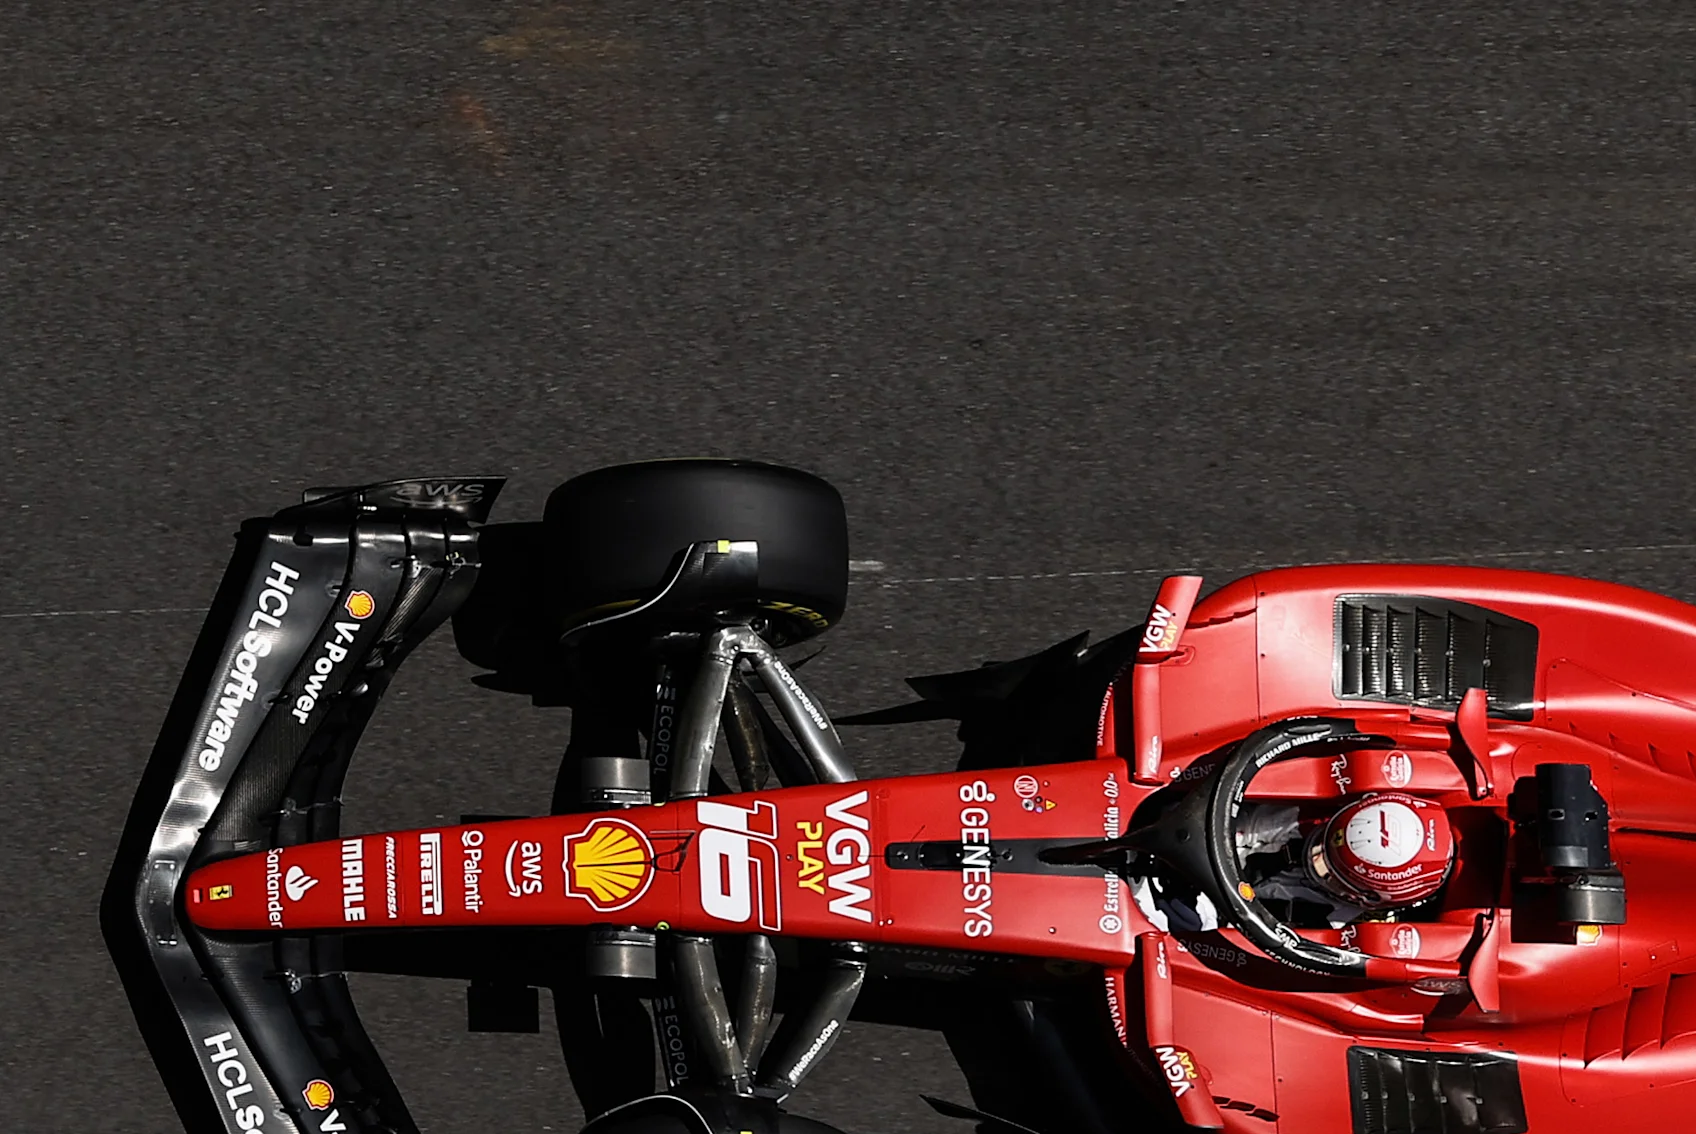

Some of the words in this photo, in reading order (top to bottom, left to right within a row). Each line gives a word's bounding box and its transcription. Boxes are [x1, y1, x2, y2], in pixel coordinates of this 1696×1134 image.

[395, 483, 485, 497] aws
[1139, 604, 1173, 652] VGW
[199, 561, 300, 772] HCLSoftware
[292, 621, 361, 725] V-Power
[653, 705, 676, 775] ECOPOL
[1255, 741, 1292, 768] RICHARD
[796, 821, 825, 895] PLAY
[825, 790, 872, 923] VGW
[1103, 806, 1120, 842] alicia
[267, 848, 284, 928] Santander
[342, 838, 366, 922] MAHLE
[386, 836, 397, 919] FRECCIAROSSA
[420, 833, 442, 915] PIRELLI
[464, 849, 483, 913] Palantir
[521, 842, 543, 894] aws
[697, 800, 781, 931] 16
[960, 807, 993, 937] GENESYS
[1368, 864, 1423, 881] Santander
[1105, 977, 1127, 1039] HARMAN
[665, 1014, 690, 1086] ECOPOL
[788, 1020, 839, 1081] #WeRaceAsOne
[1155, 1047, 1191, 1097] VGW
[1177, 1051, 1198, 1080] PLAY
